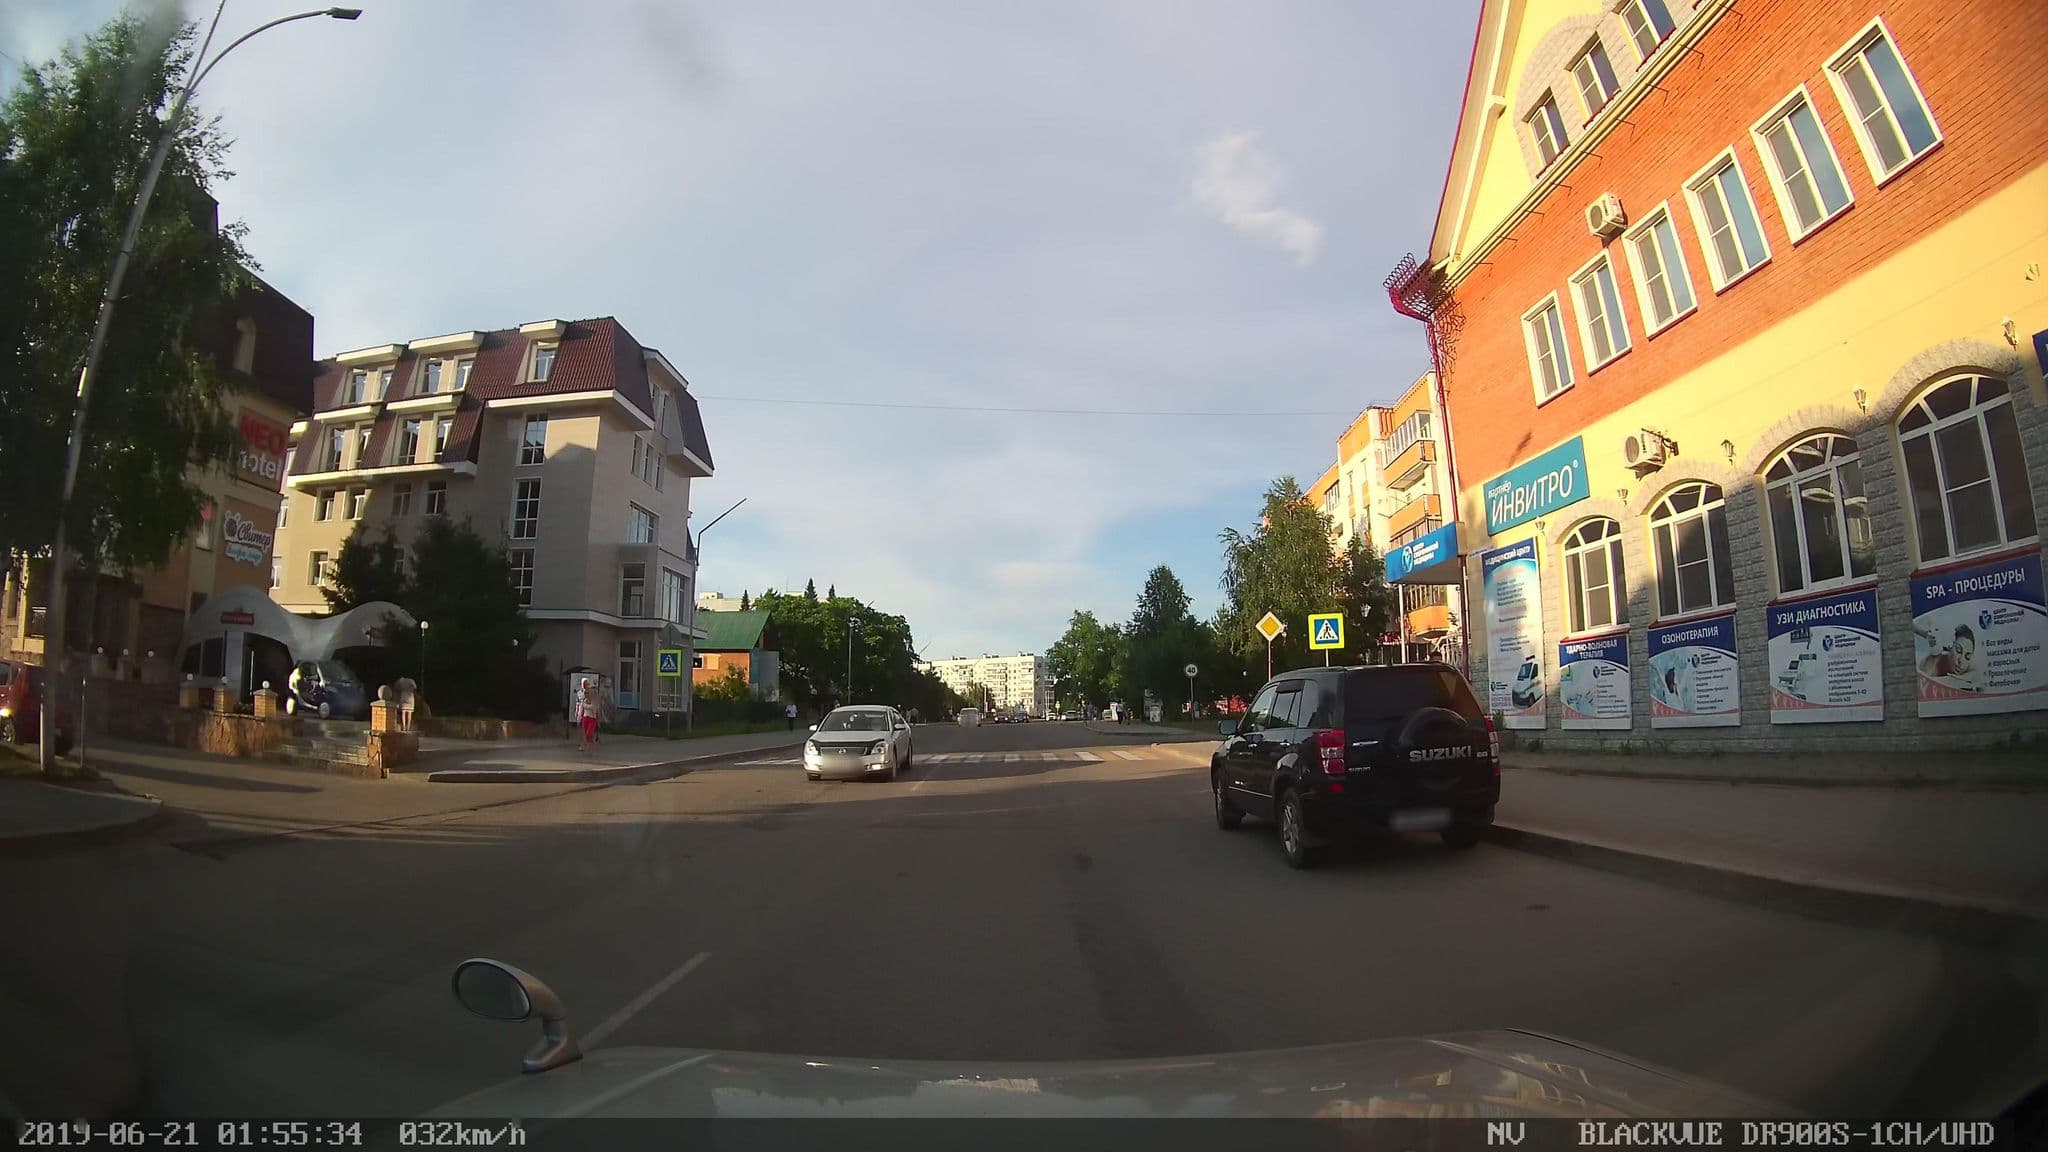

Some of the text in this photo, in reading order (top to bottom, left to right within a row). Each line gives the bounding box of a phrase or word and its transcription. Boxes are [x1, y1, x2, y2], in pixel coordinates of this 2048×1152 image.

[1492, 465, 1573, 526] ИНВИТРО
[1926, 584, 1946, 599] SPA
[1954, 567, 2026, 594] ПРОЦЕДУРЫ
[1776, 599, 1867, 625] УЗИ ДИАГНОСТИКА
[1661, 626, 1719, 644] ОЗОНОТЕРАПИЯ
[1409, 745, 1472, 763] SUZUKI
